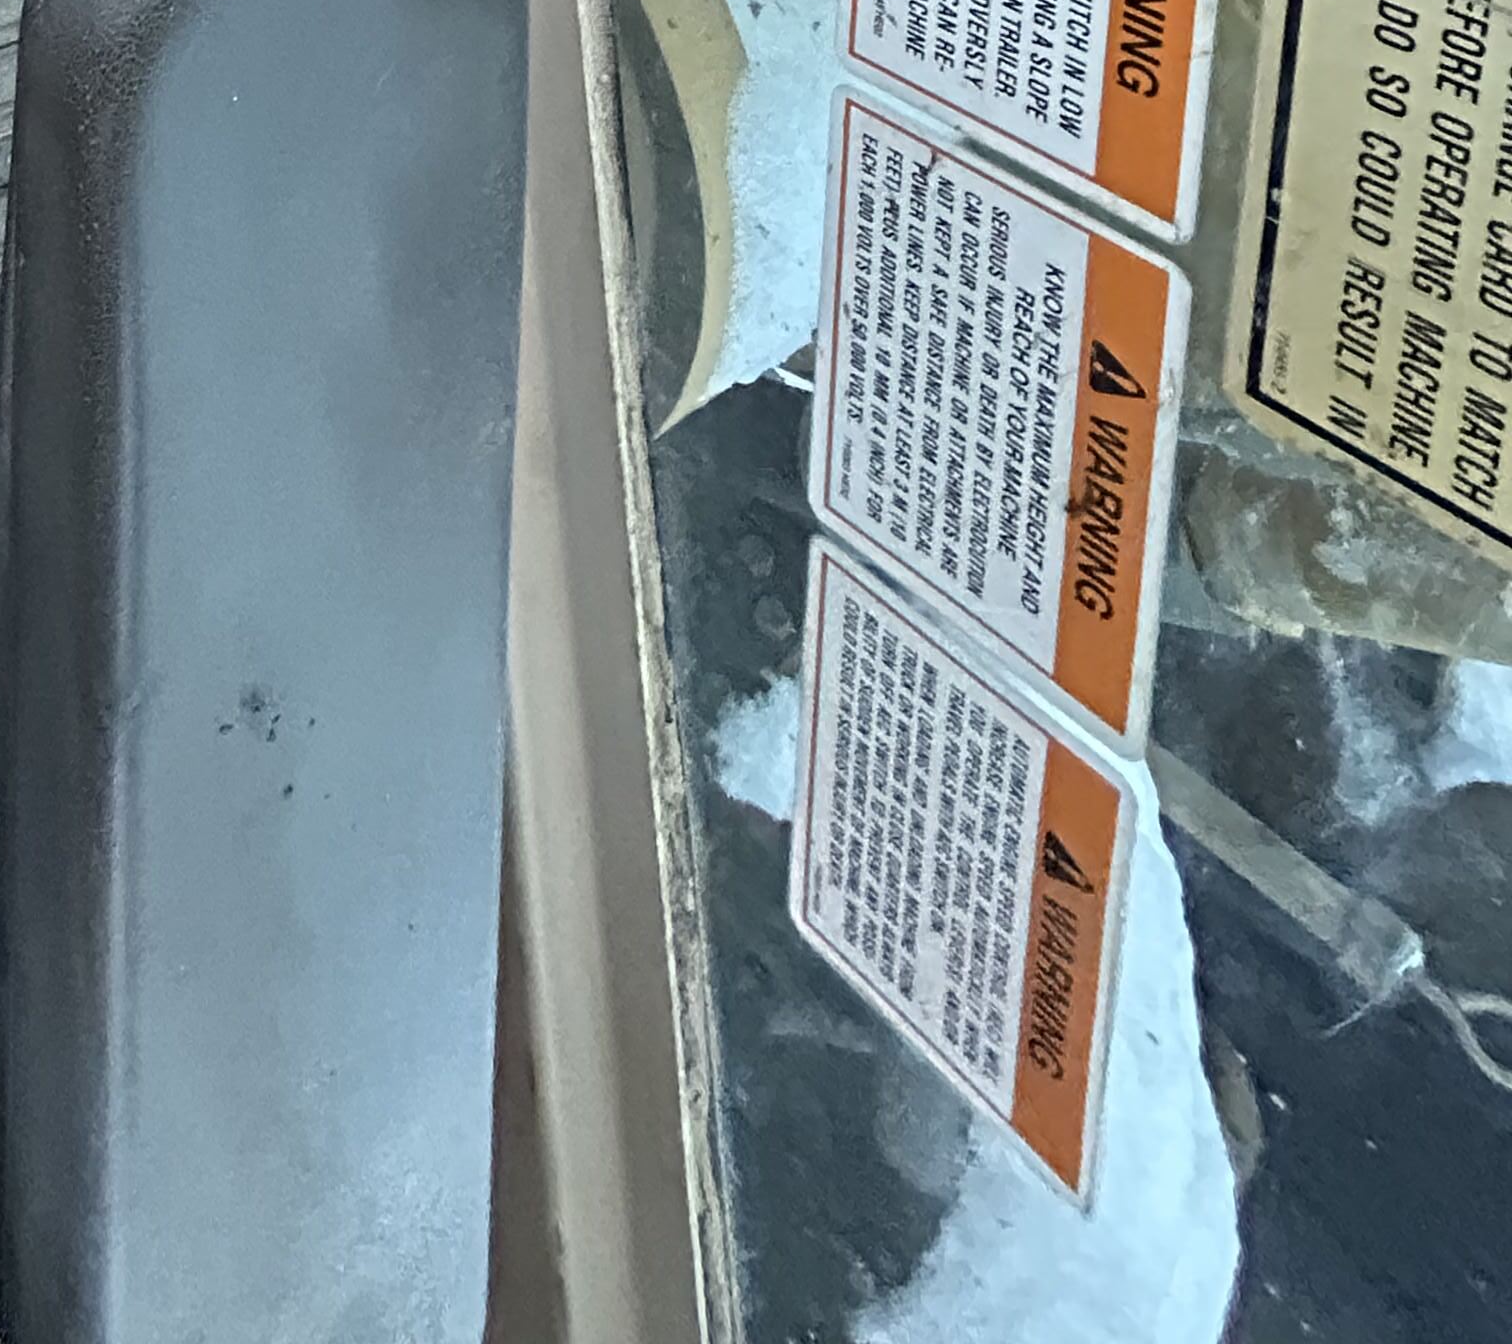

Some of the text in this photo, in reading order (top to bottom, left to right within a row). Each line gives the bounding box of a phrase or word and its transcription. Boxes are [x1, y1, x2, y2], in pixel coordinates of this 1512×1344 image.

[933, 36, 956, 73] RE-
[994, 15, 1023, 98] TRAILER.
[1031, 30, 1054, 49] A
[1025, 51, 1053, 124] SLOPE
[1062, 54, 1087, 83] IN
[1365, 65, 1411, 119] SO
[1057, 83, 1085, 140] LOW
[859, 130, 879, 180] EACH
[882, 144, 904, 196] FEET)
[908, 160, 932, 223] POWER
[1350, 130, 1403, 248] COULD
[1410, 111, 1475, 303] OPERATING
[854, 220, 874, 278] VOLTS
[852, 272, 871, 322] OVER
[876, 243, 898, 339] ADDITIONAL
[903, 278, 922, 324] KEEP
[1333, 257, 1386, 391] RESULT
[874, 346, 892, 368] 10
[897, 322, 920, 404] DISTANCE
[914, 174, 956, 557] NOT KEPT A SAFE DISTANCE FROM ELECTRICAL
[1468, 331, 1512, 383] TO
[872, 369, 891, 404] MM
[939, 190, 983, 580] CAN OCCUR IF MACHINE OR ATTACHMENTS ARE
[966, 205, 1011, 600] SERIOUS INJURY OR DEATH BY ELECTROCUTION
[1387, 309, 1448, 469] MACHINE.
[896, 401, 915, 430] AT
[996, 286, 1036, 562] REACH OF YOUR MACHINE
[1020, 262, 1066, 616] KNOW THE MAXIMUM HEIGHT AND
[1326, 394, 1368, 440] IN
[866, 439, 886, 487] INCH)
[893, 427, 912, 481] LEAST
[1450, 386, 1508, 512] MATCH
[866, 488, 884, 524] FOR
[891, 492, 909, 514] M
[892, 477, 910, 494] 3
[1073, 414, 1129, 621] WARNING
